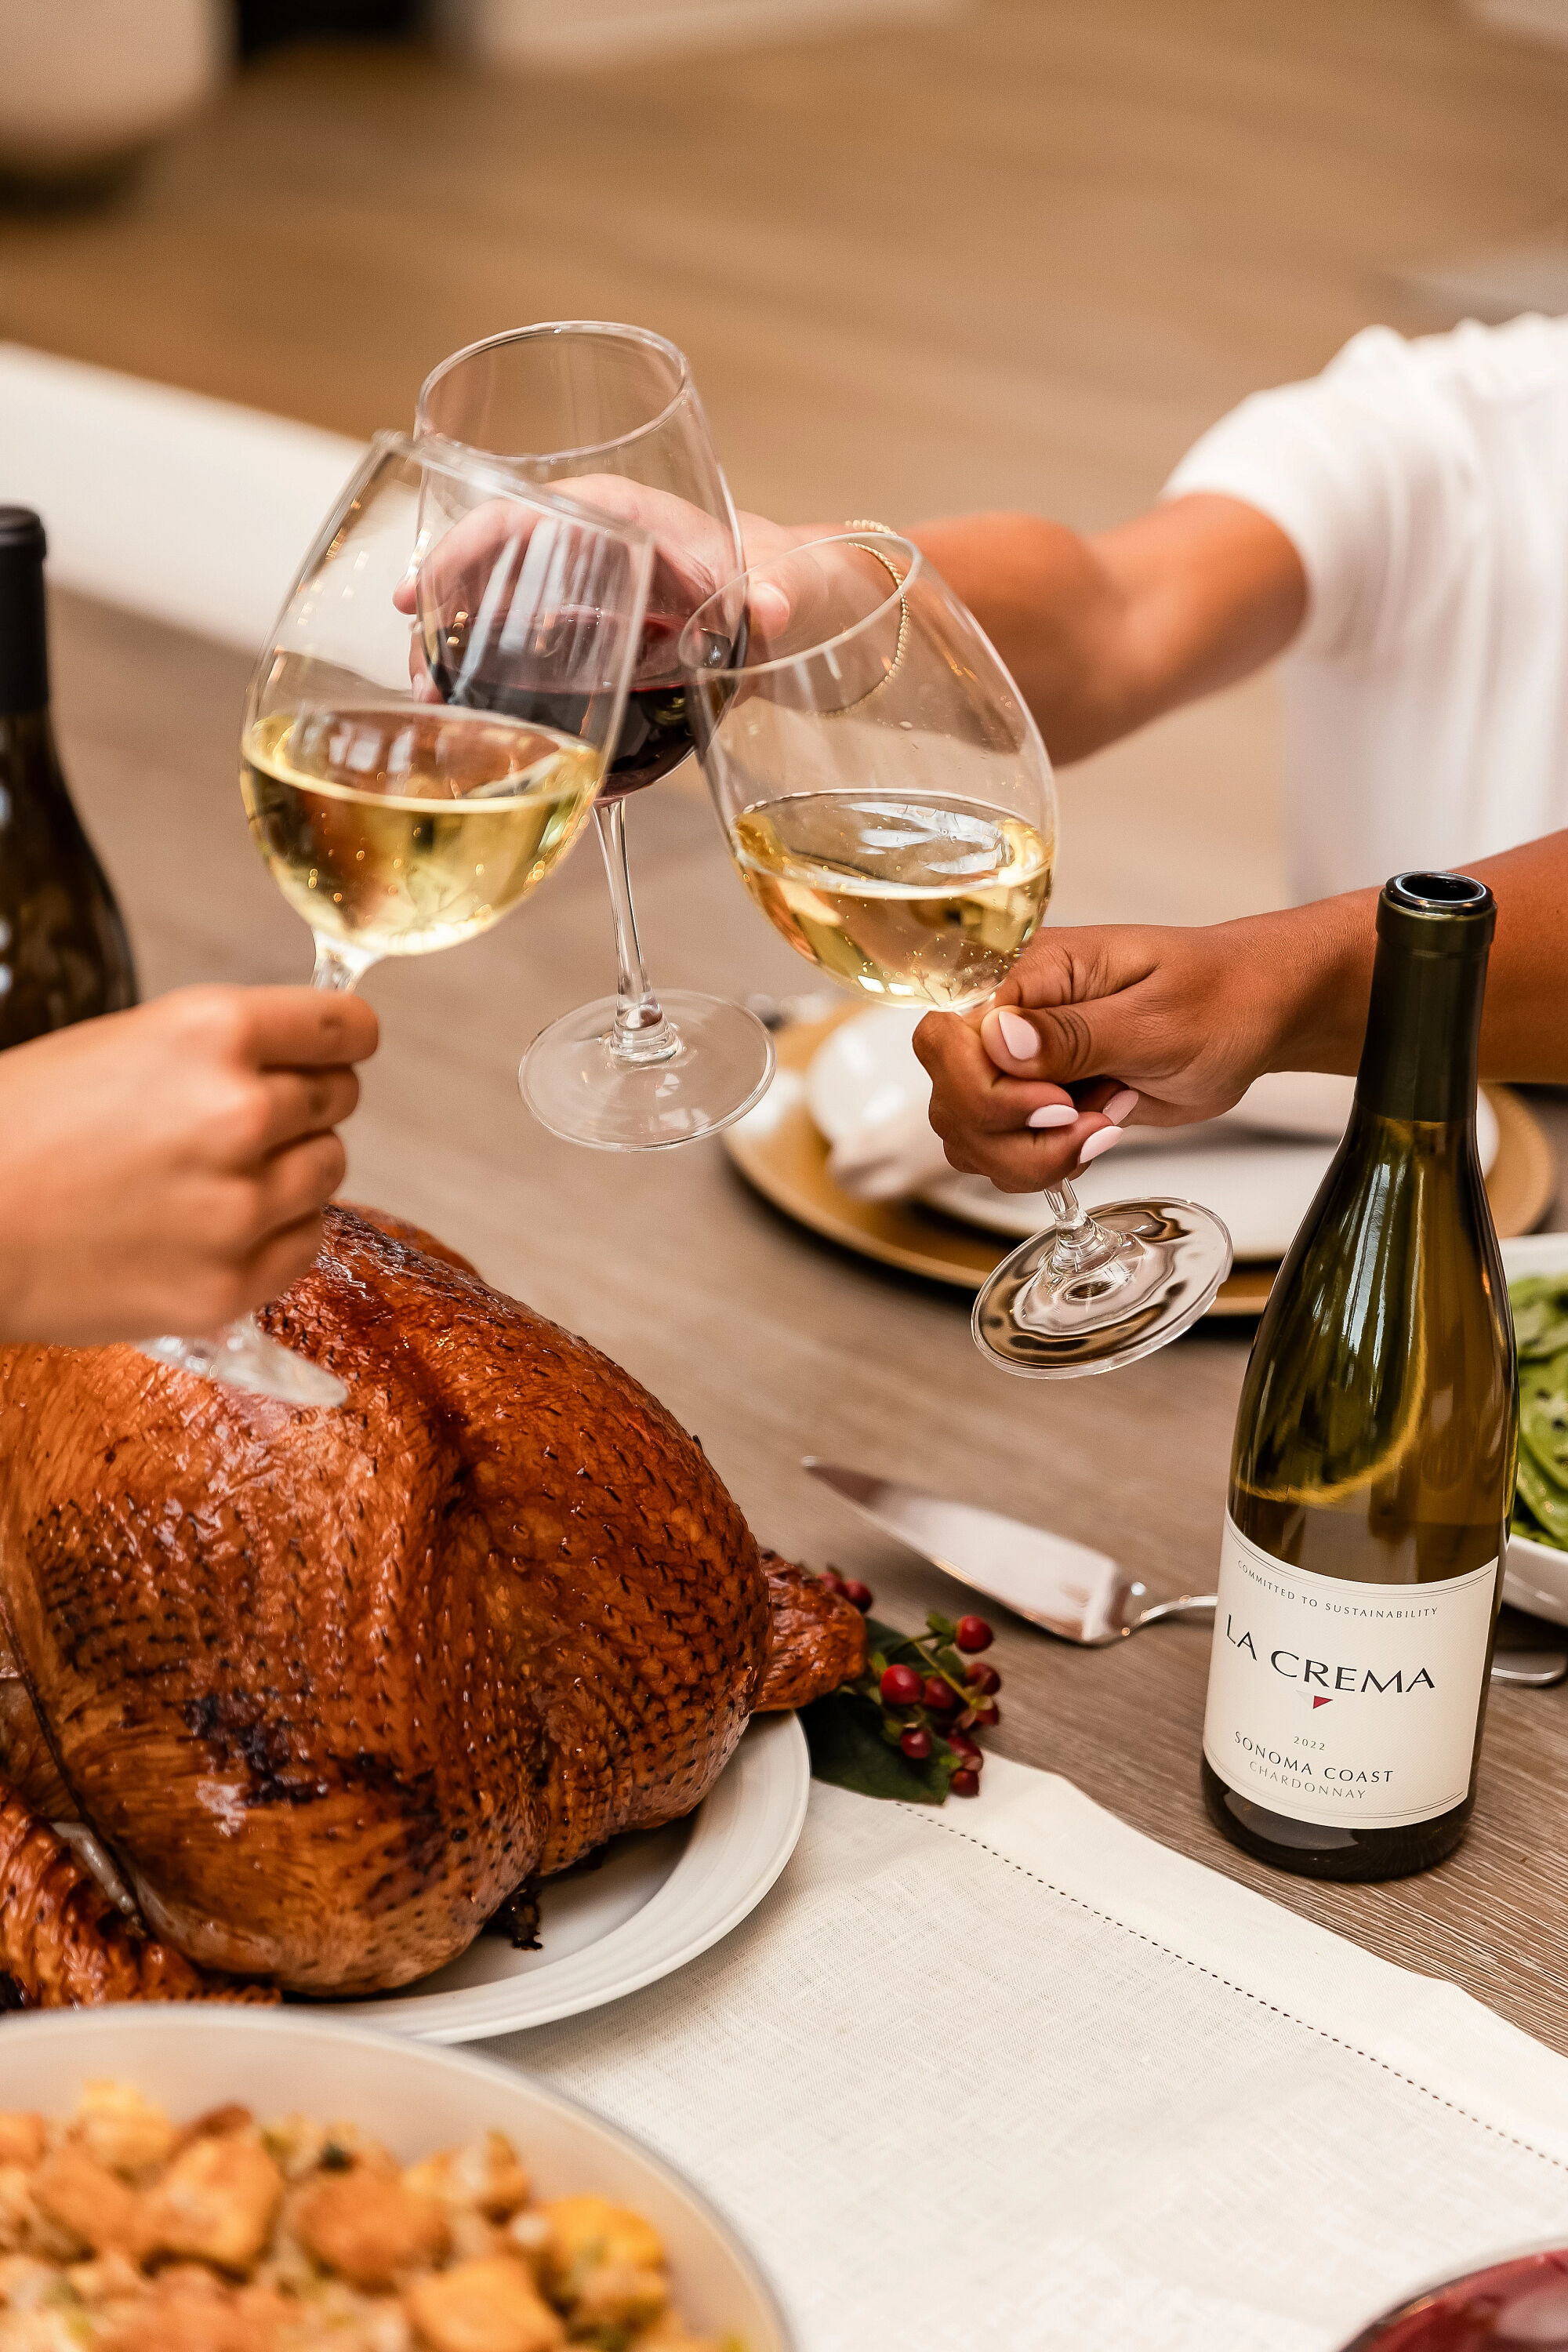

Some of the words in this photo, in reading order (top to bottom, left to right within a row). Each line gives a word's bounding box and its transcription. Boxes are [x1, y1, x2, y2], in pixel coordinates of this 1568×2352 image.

[1237, 1559, 1295, 1600] COMMITTED
[1301, 1595, 1318, 1608] TO
[1325, 1602, 1439, 1618] SUSTAINABILITY
[1226, 1613, 1258, 1661] LA
[1270, 1650, 1436, 1693] CREMA
[1234, 1731, 1312, 1775] SONOMA
[1323, 1767, 1394, 1783] COAST
[1293, 1736, 1326, 1751] 2022
[1249, 1761, 1367, 1799] CHARDONNAY
